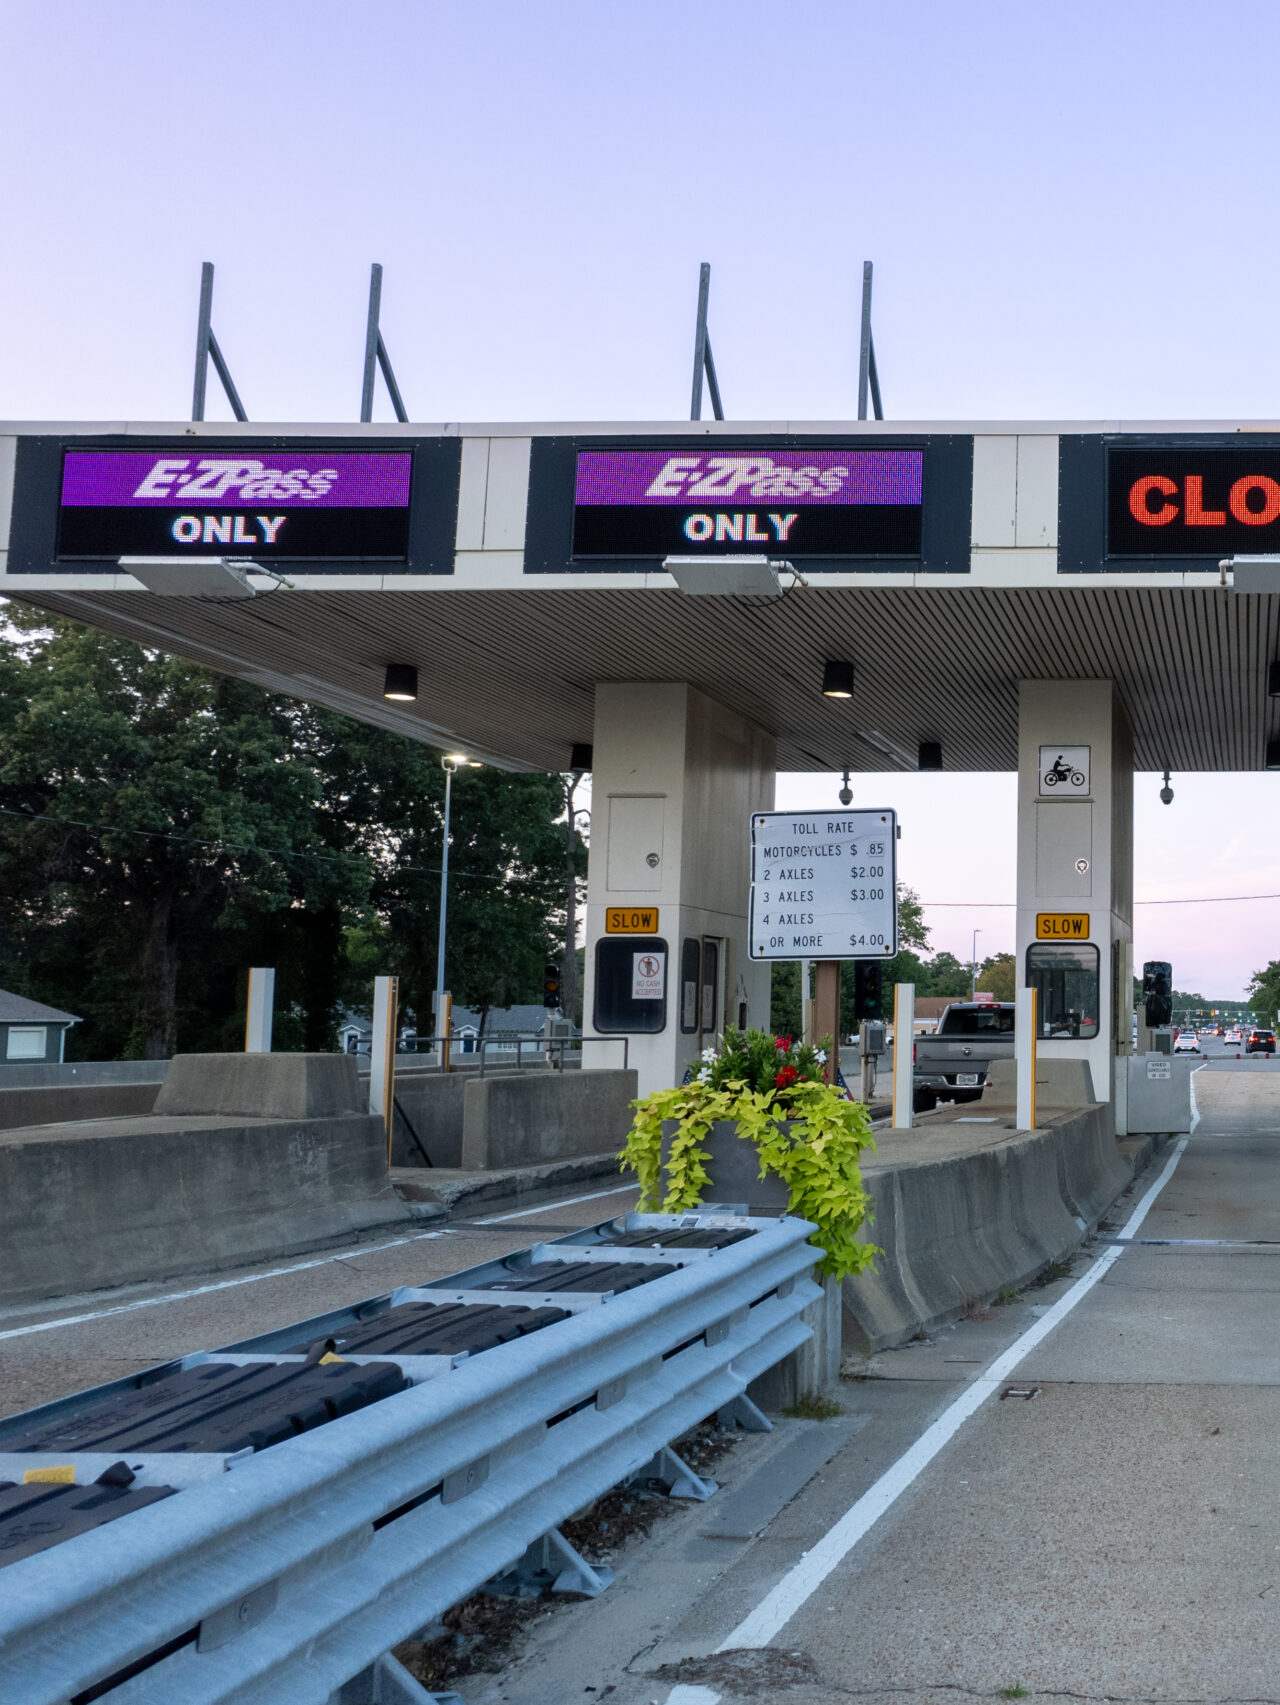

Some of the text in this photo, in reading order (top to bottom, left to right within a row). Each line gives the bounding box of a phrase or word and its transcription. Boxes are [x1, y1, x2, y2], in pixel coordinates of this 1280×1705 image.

[171, 516, 286, 543] ONLY
[684, 514, 798, 541] ONLY
[793, 822, 853, 834] TOLL RATE
[764, 844, 841, 858] MOTORCYCLES
[851, 844, 857, 856] $
[764, 866, 884, 881] 2 AXLES $2.00
[763, 889, 884, 903] 3 AXLES $3.00
[612, 913, 651, 928] SLOW
[763, 913, 813, 924] 4 AXLES
[1043, 919, 1082, 934] SLOW
[770, 934, 884, 948] OR MORE $4.00
